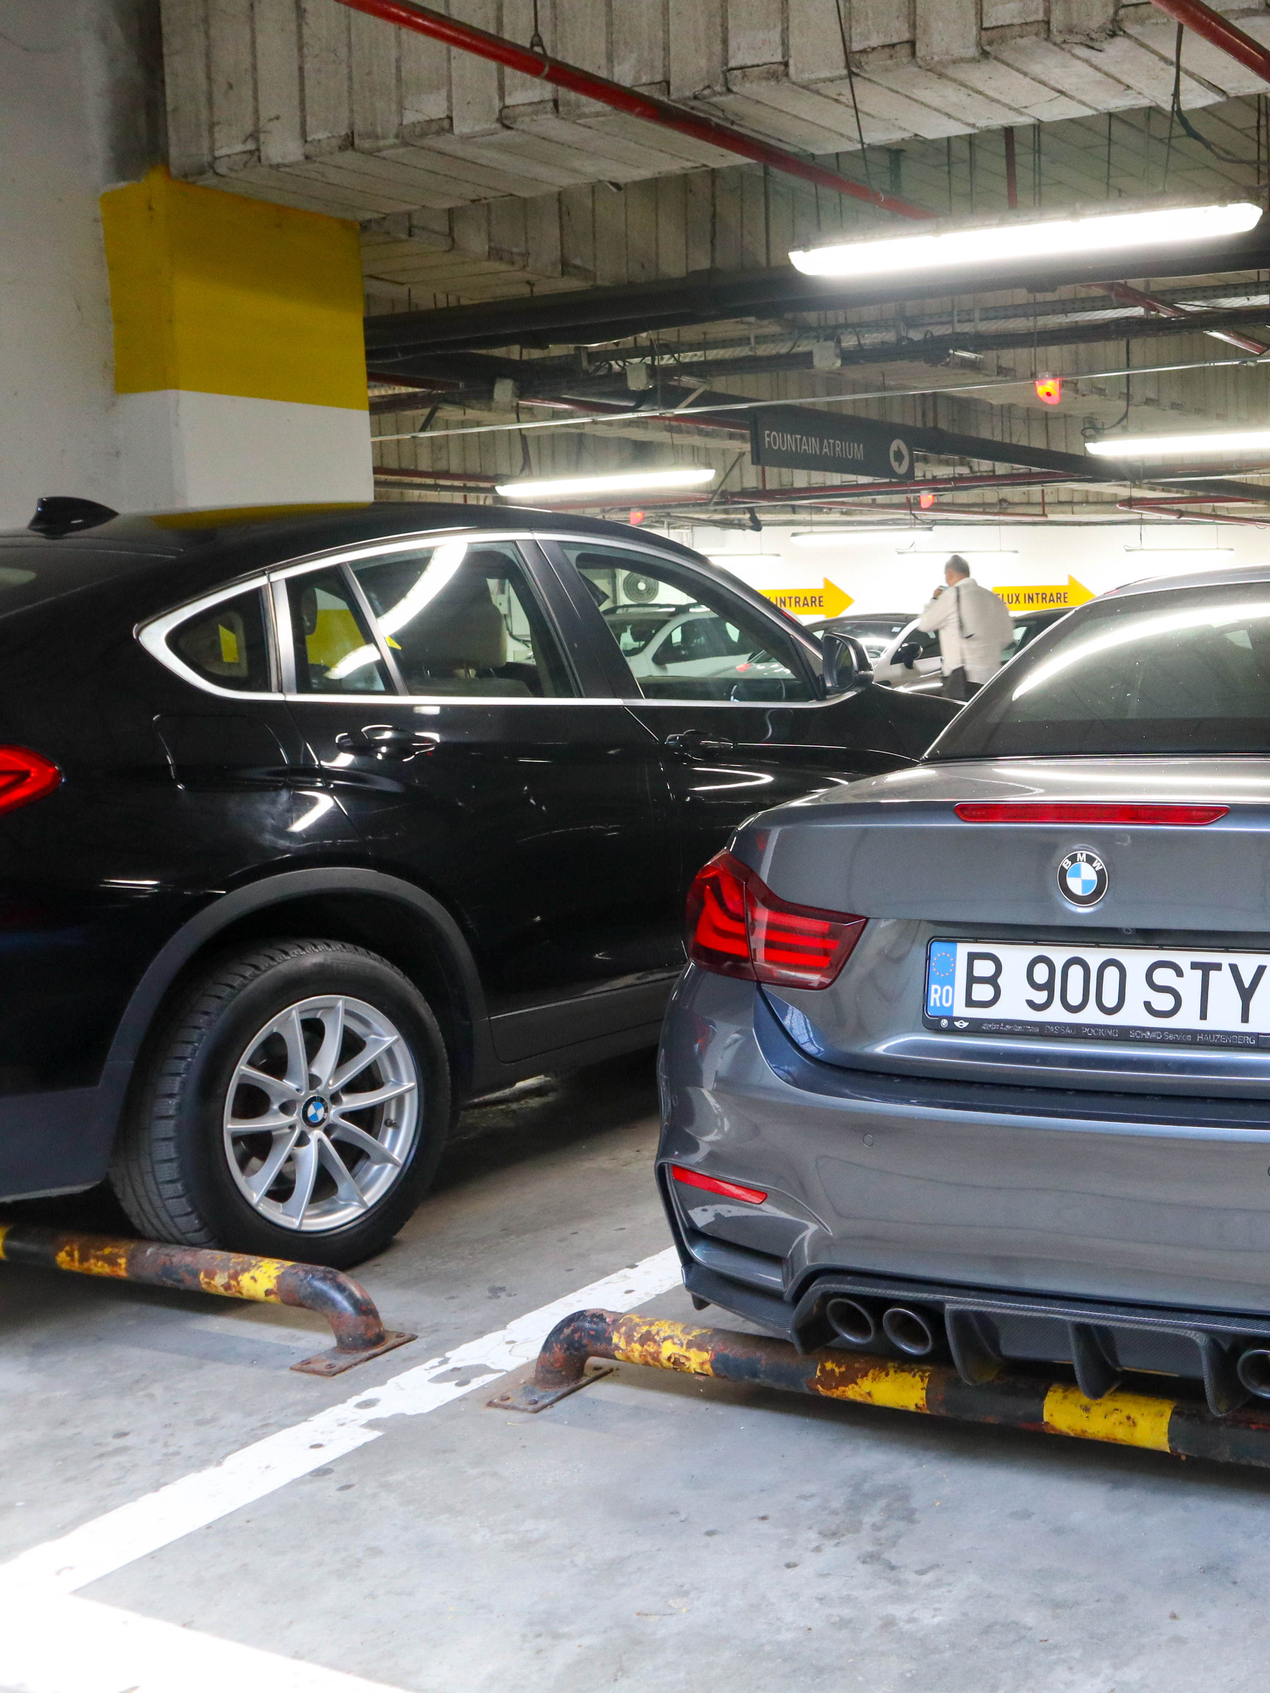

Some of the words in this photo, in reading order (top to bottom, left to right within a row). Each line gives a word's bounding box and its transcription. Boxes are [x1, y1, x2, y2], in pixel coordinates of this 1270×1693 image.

[764, 430, 820, 455] FOUNTAIN
[822, 439, 864, 460] ATRIUM
[775, 596, 824, 607] INTRARE
[1024, 592, 1068, 604] INTRARE
[1061, 852, 1104, 871] BMW
[930, 984, 953, 1008] RO
[965, 951, 1003, 1009] B
[1025, 954, 1127, 1015] 900
[1143, 959, 1267, 1023] STY
[1163, 1031, 1192, 1041] Service
